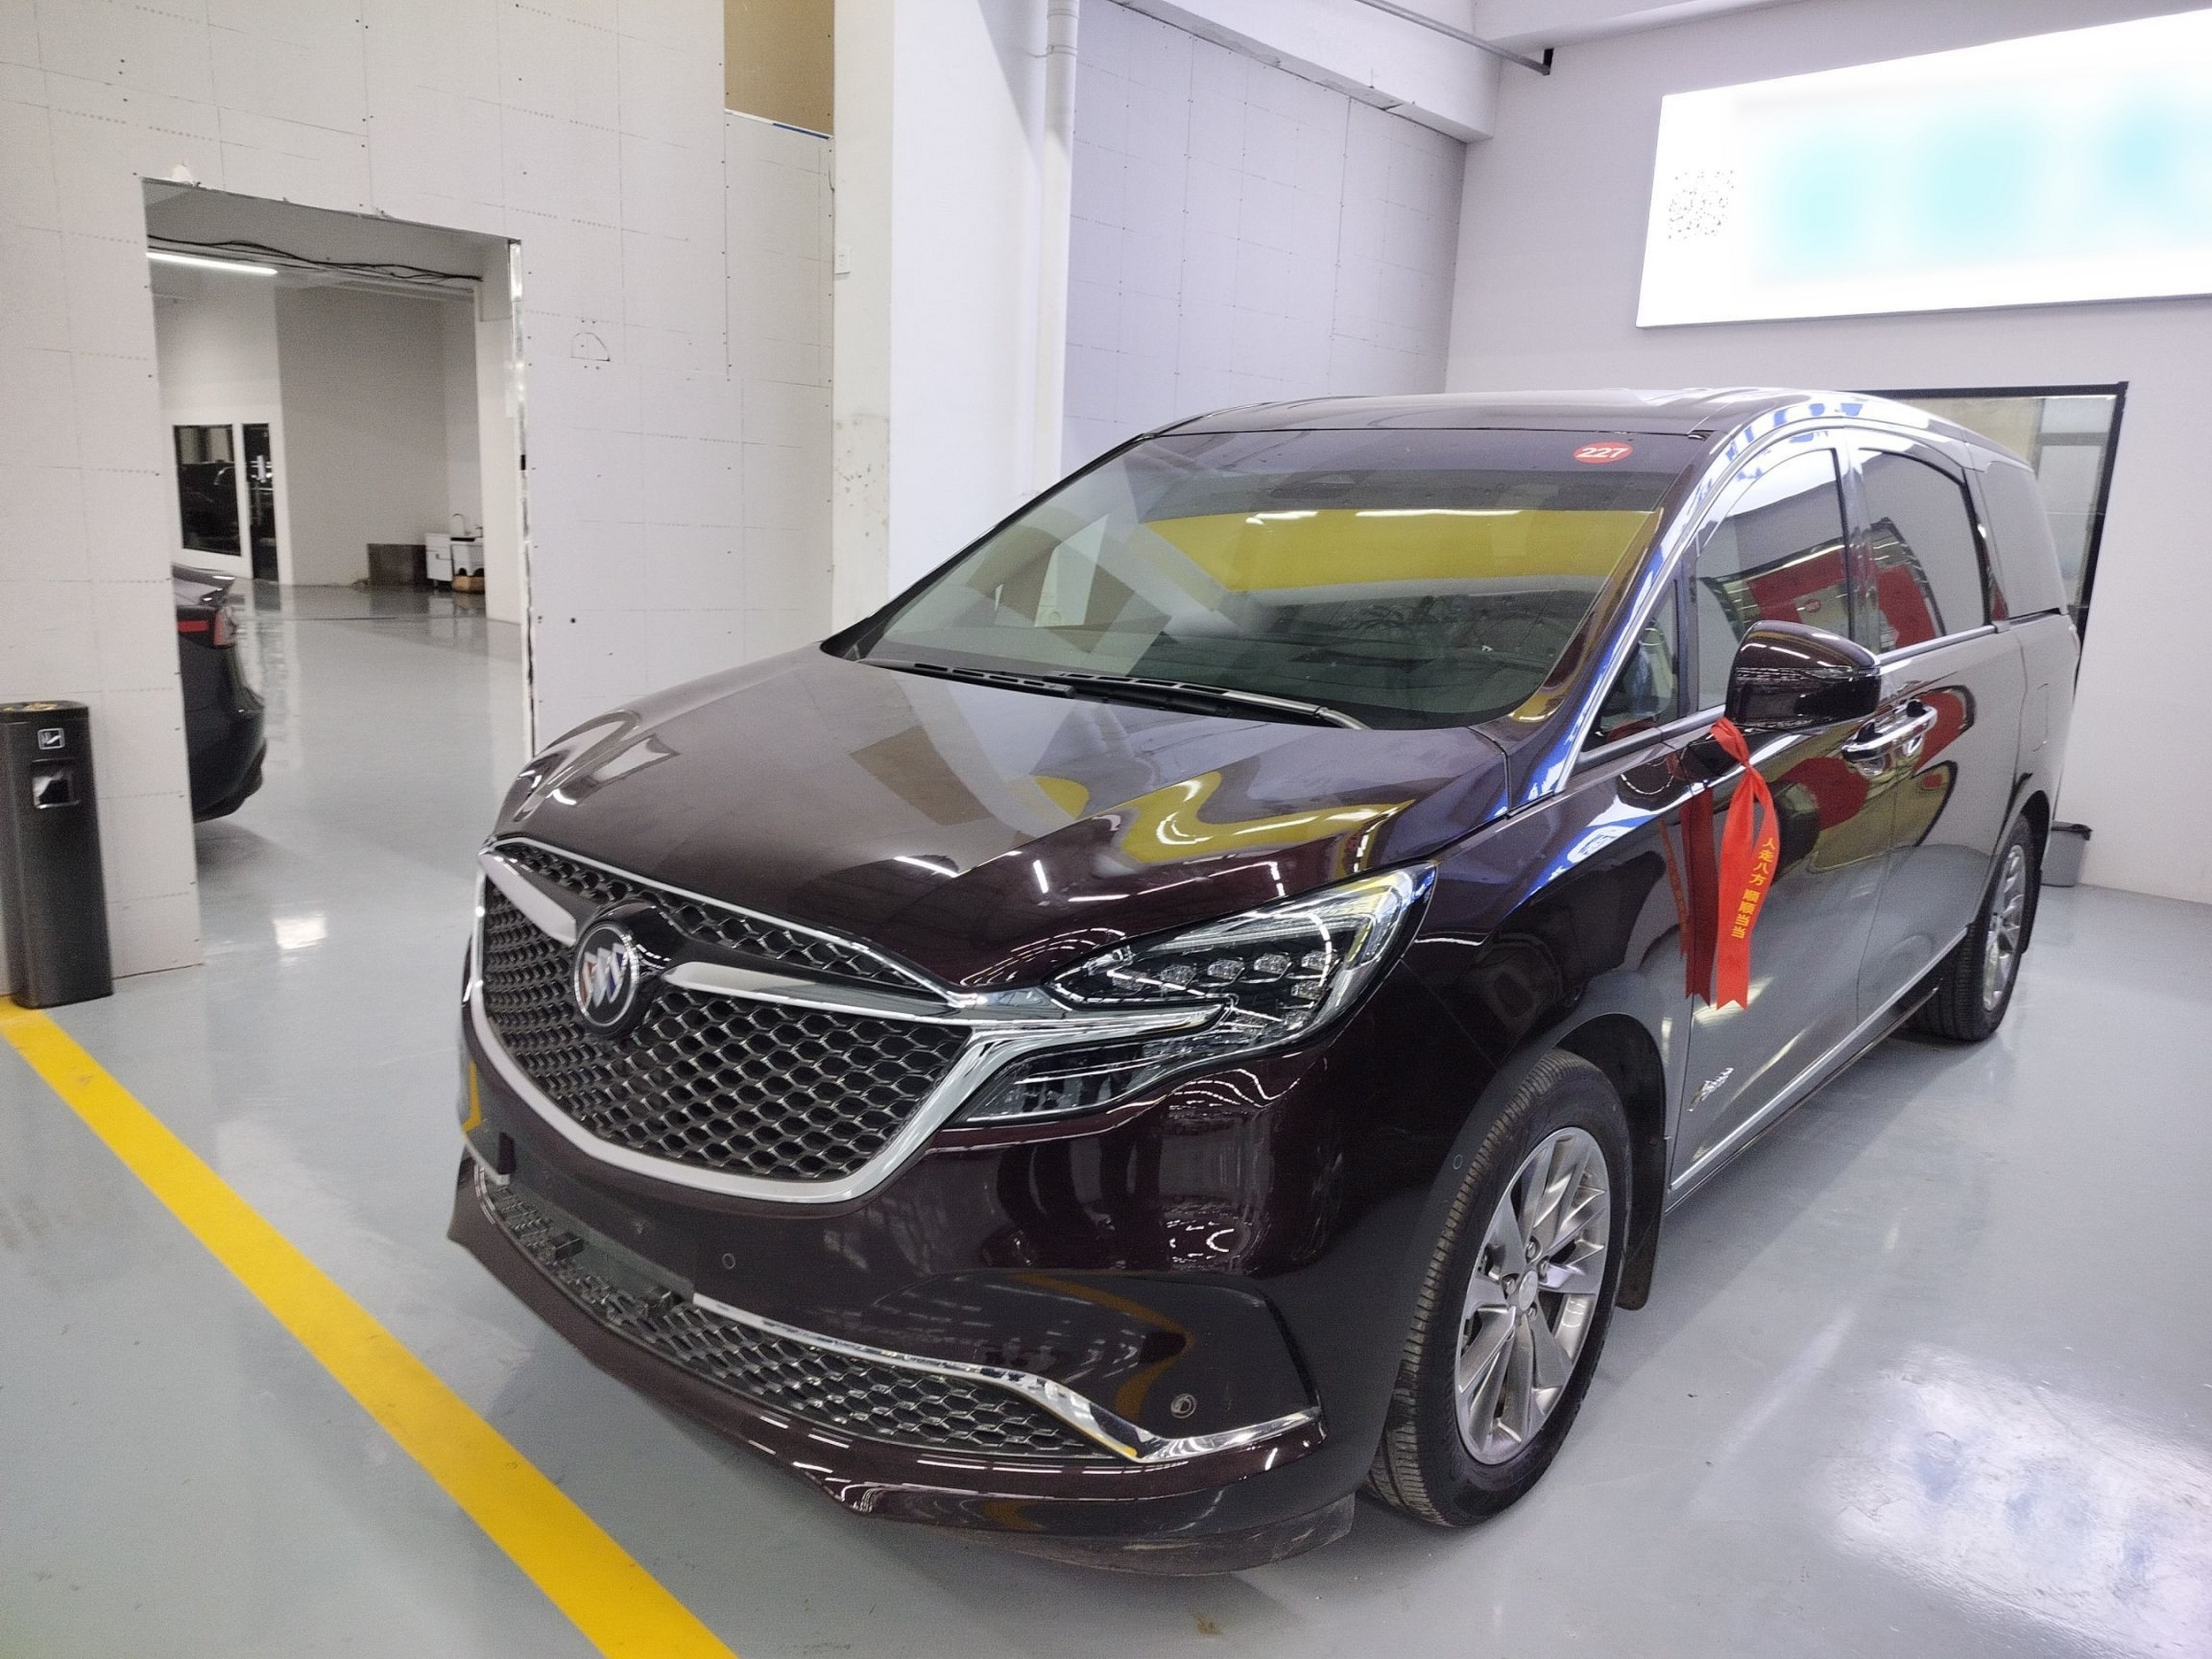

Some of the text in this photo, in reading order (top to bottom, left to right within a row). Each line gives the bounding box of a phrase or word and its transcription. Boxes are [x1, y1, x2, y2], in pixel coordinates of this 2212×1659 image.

[1576, 447, 1629, 458] 227
[1749, 838, 1775, 885] 人走八方
